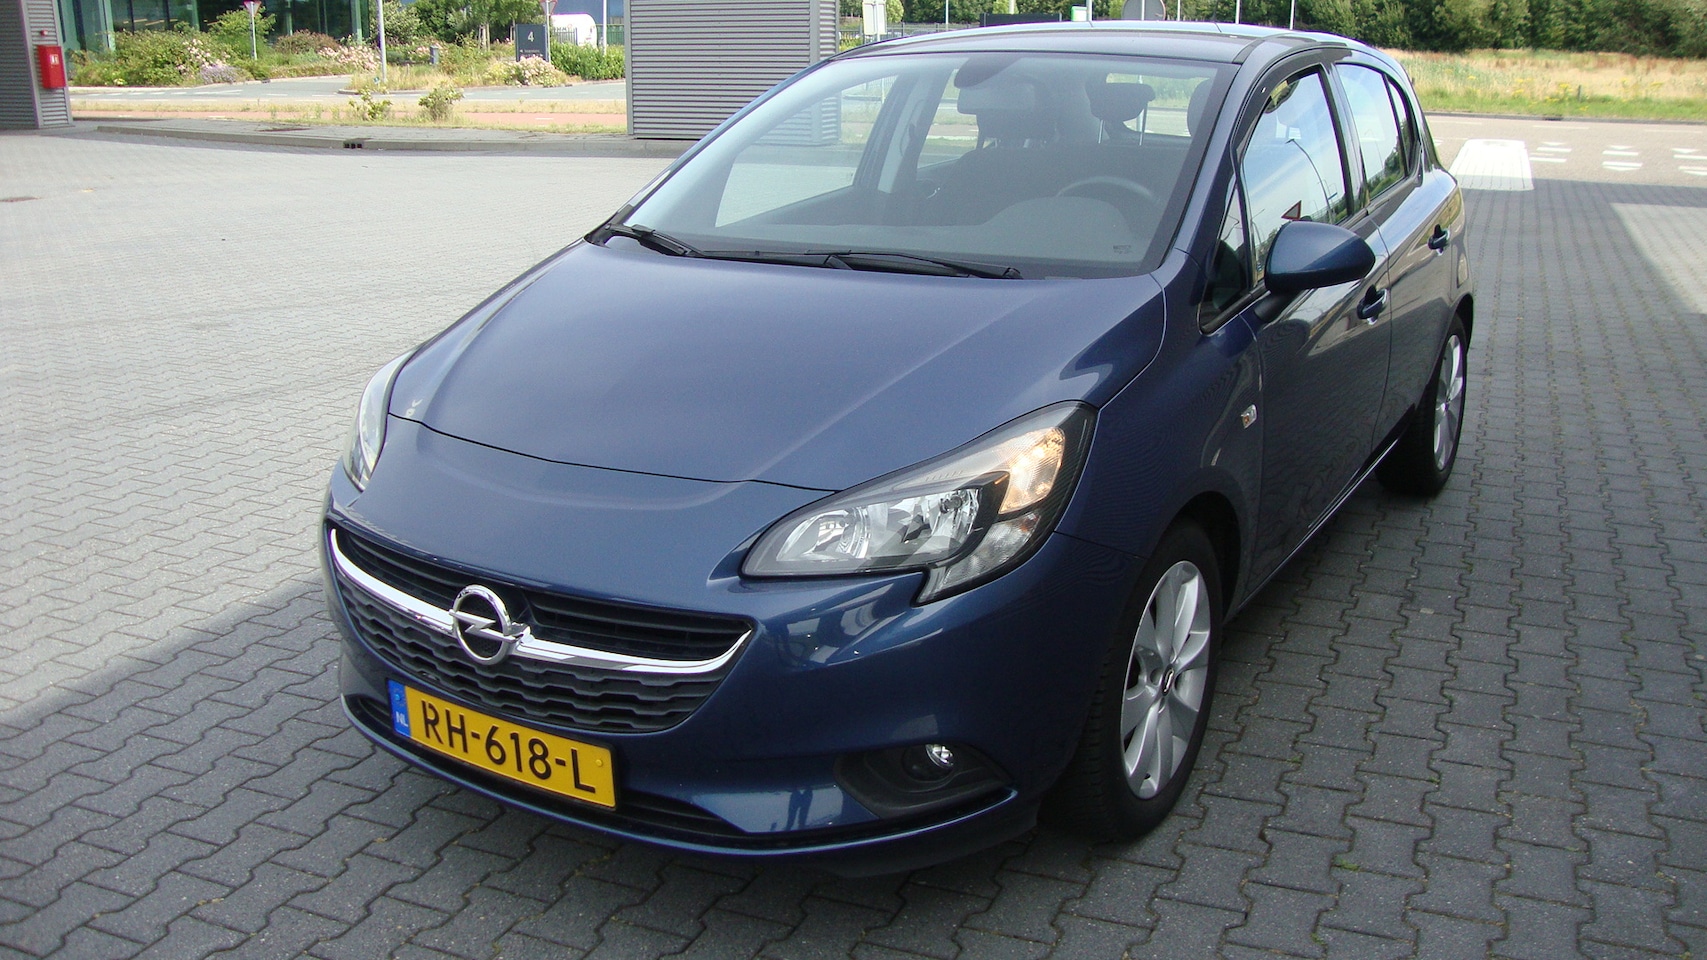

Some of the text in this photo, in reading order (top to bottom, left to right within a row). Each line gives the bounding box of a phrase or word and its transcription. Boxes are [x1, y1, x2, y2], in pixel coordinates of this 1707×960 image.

[528, 31, 534, 42] 4
[396, 713, 409, 727] NL
[421, 700, 595, 794] RH-618-L
